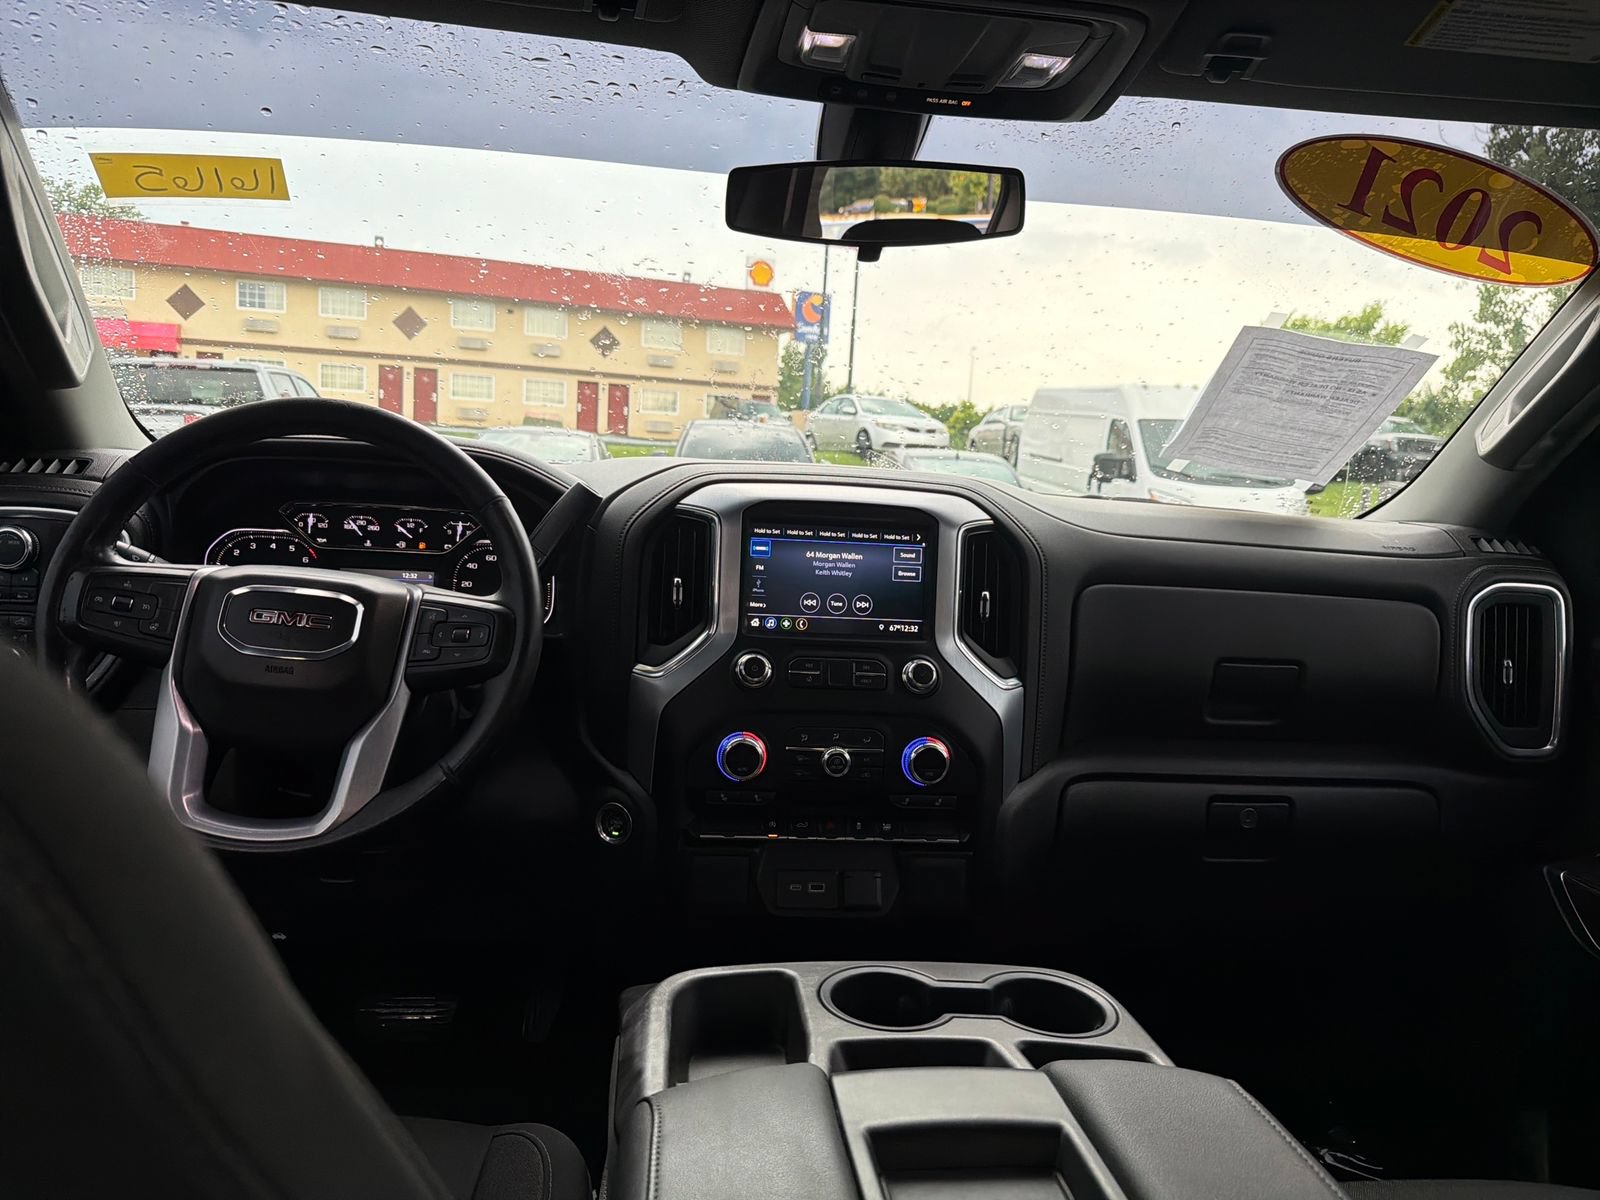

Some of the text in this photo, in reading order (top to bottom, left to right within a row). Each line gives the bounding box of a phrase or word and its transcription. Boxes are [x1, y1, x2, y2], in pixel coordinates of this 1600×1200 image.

[485, 554, 498, 562] 60
[815, 551, 841, 561] Morgan
[841, 552, 864, 560] Wallen
[466, 562, 478, 570] 40
[812, 560, 836, 569] Morgan
[831, 570, 852, 578] Whitley
[460, 580, 473, 588] 20
[248, 608, 334, 630] GMC
[264, 665, 295, 675] AIRBAG
